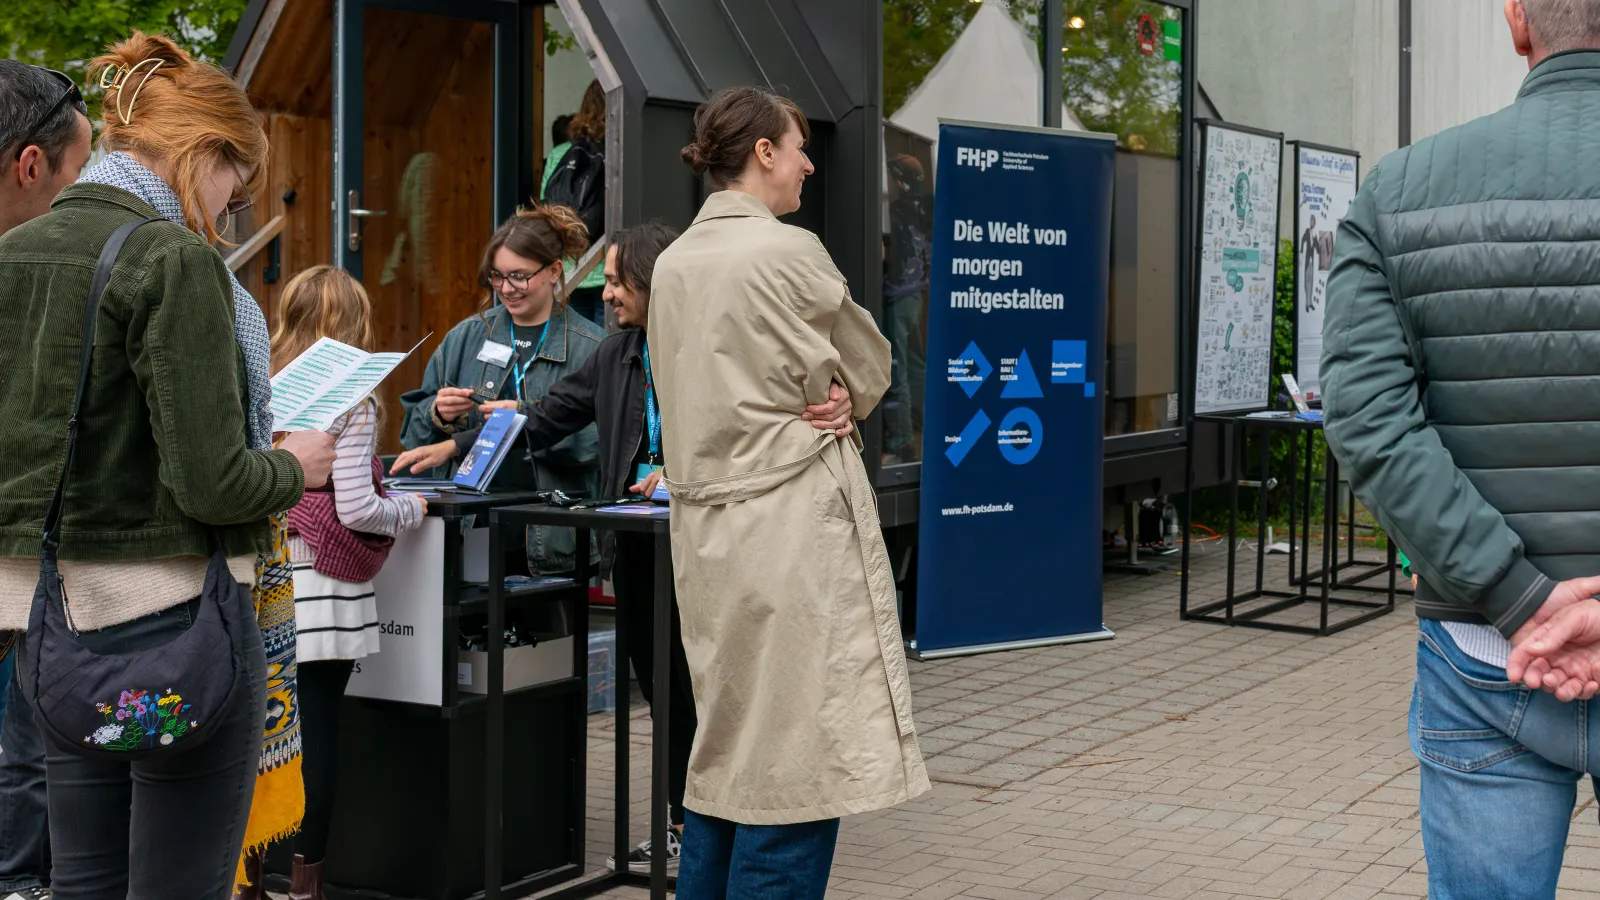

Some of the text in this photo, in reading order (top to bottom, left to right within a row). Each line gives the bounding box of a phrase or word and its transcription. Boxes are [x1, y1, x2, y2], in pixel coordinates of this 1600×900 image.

[954, 219, 1067, 245] Die Welt von
[952, 258, 1023, 281] morgen
[950, 286, 1064, 313] mitgestalten
[942, 502, 1014, 516] www.fh-potsdam.de
[379, 620, 414, 636] sdam
